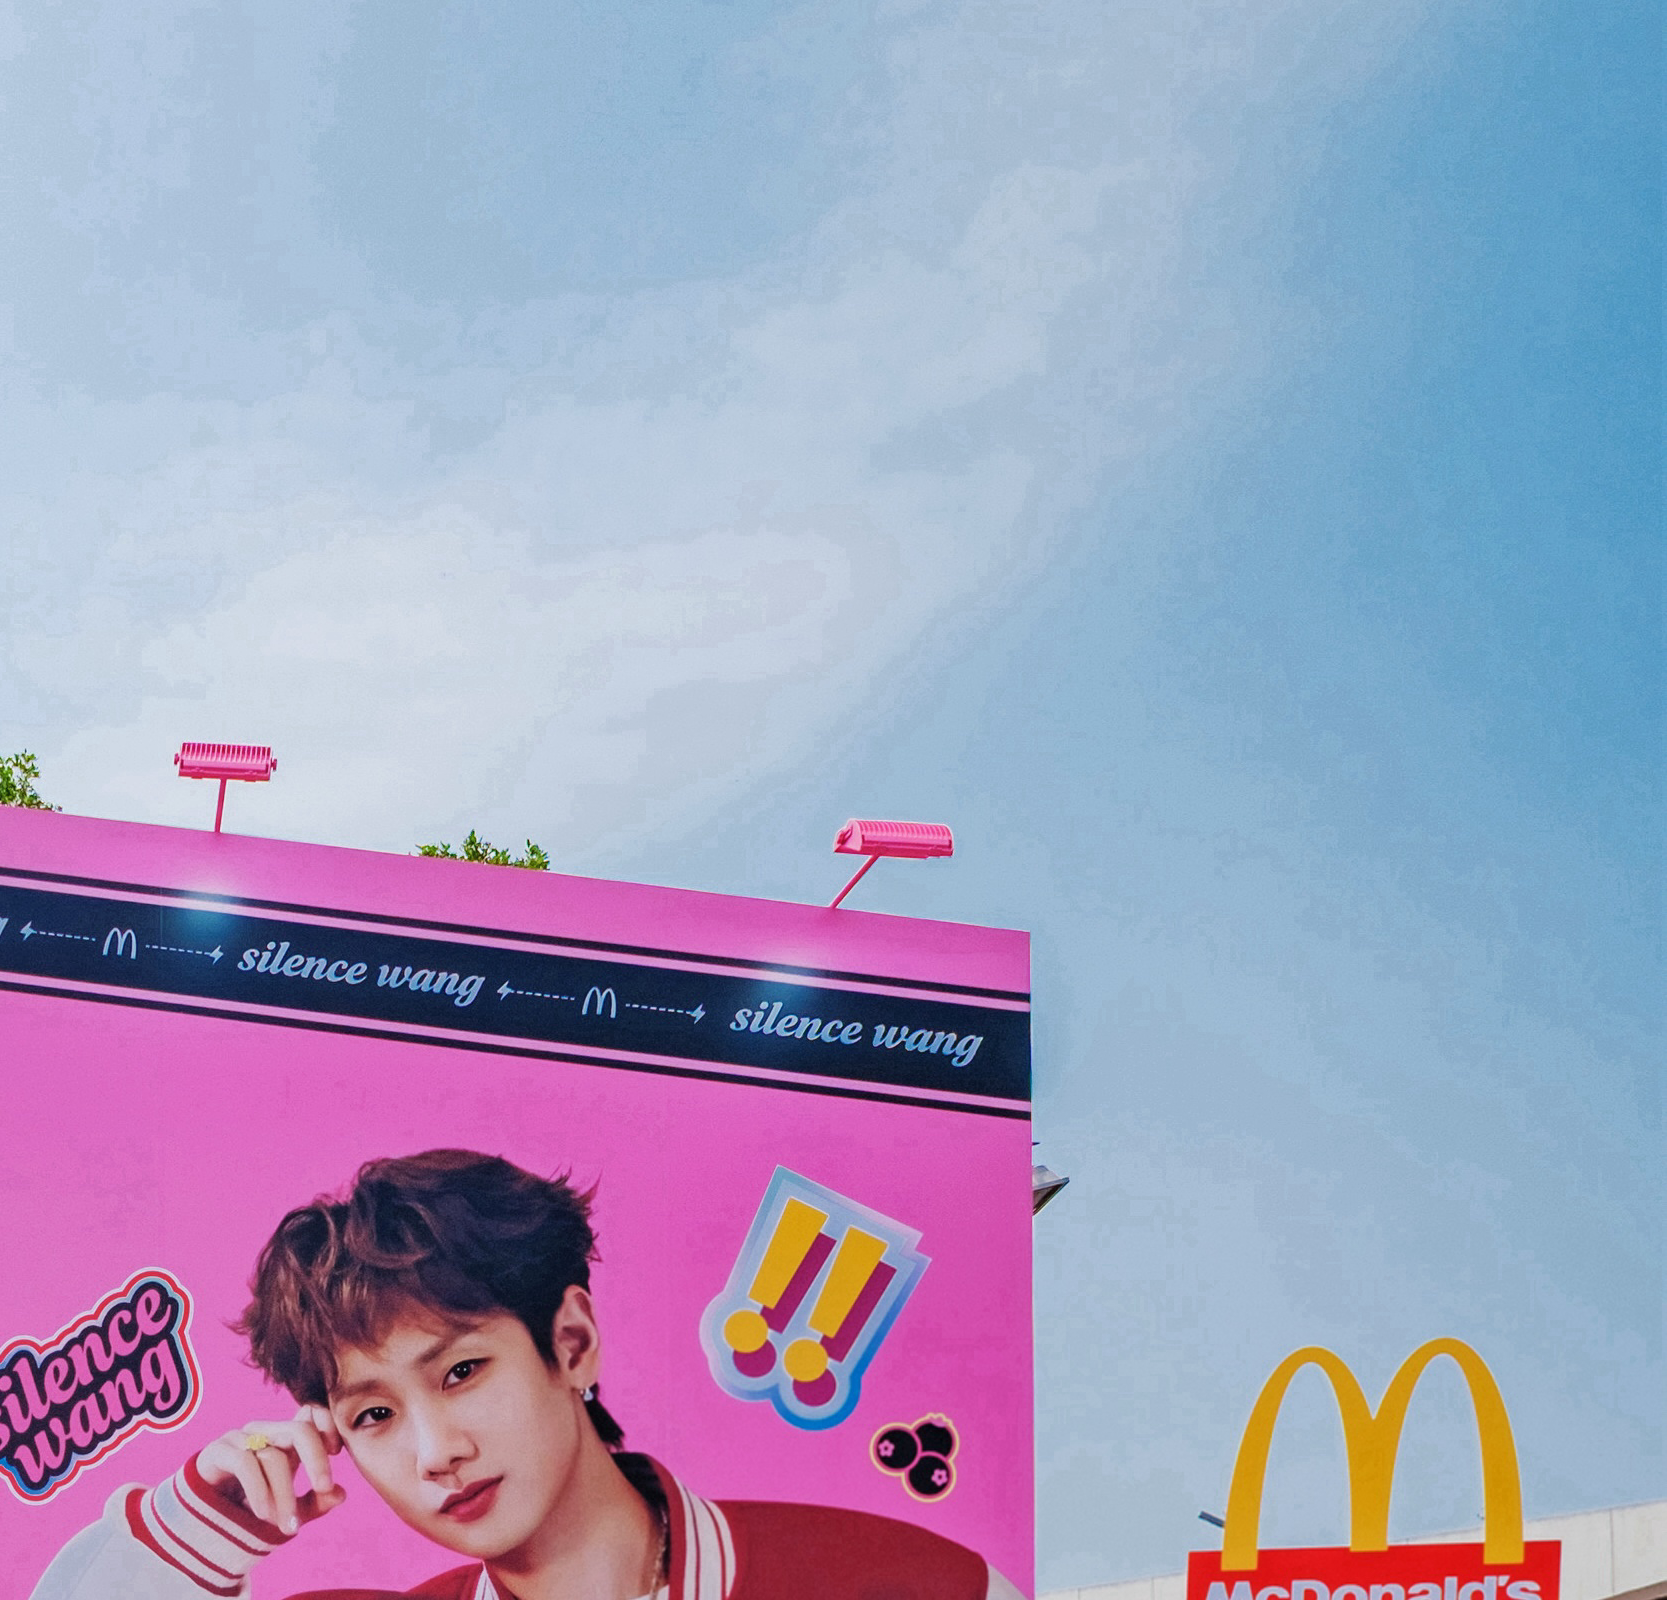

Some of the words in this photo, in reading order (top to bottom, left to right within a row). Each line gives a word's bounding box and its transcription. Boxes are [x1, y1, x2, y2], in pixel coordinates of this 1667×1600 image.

[237, 941, 368, 985] silence
[377, 965, 486, 1007] wang
[729, 1001, 864, 1045] silence
[872, 1022, 985, 1068] wang
[13, 1338, 181, 1484] wang
